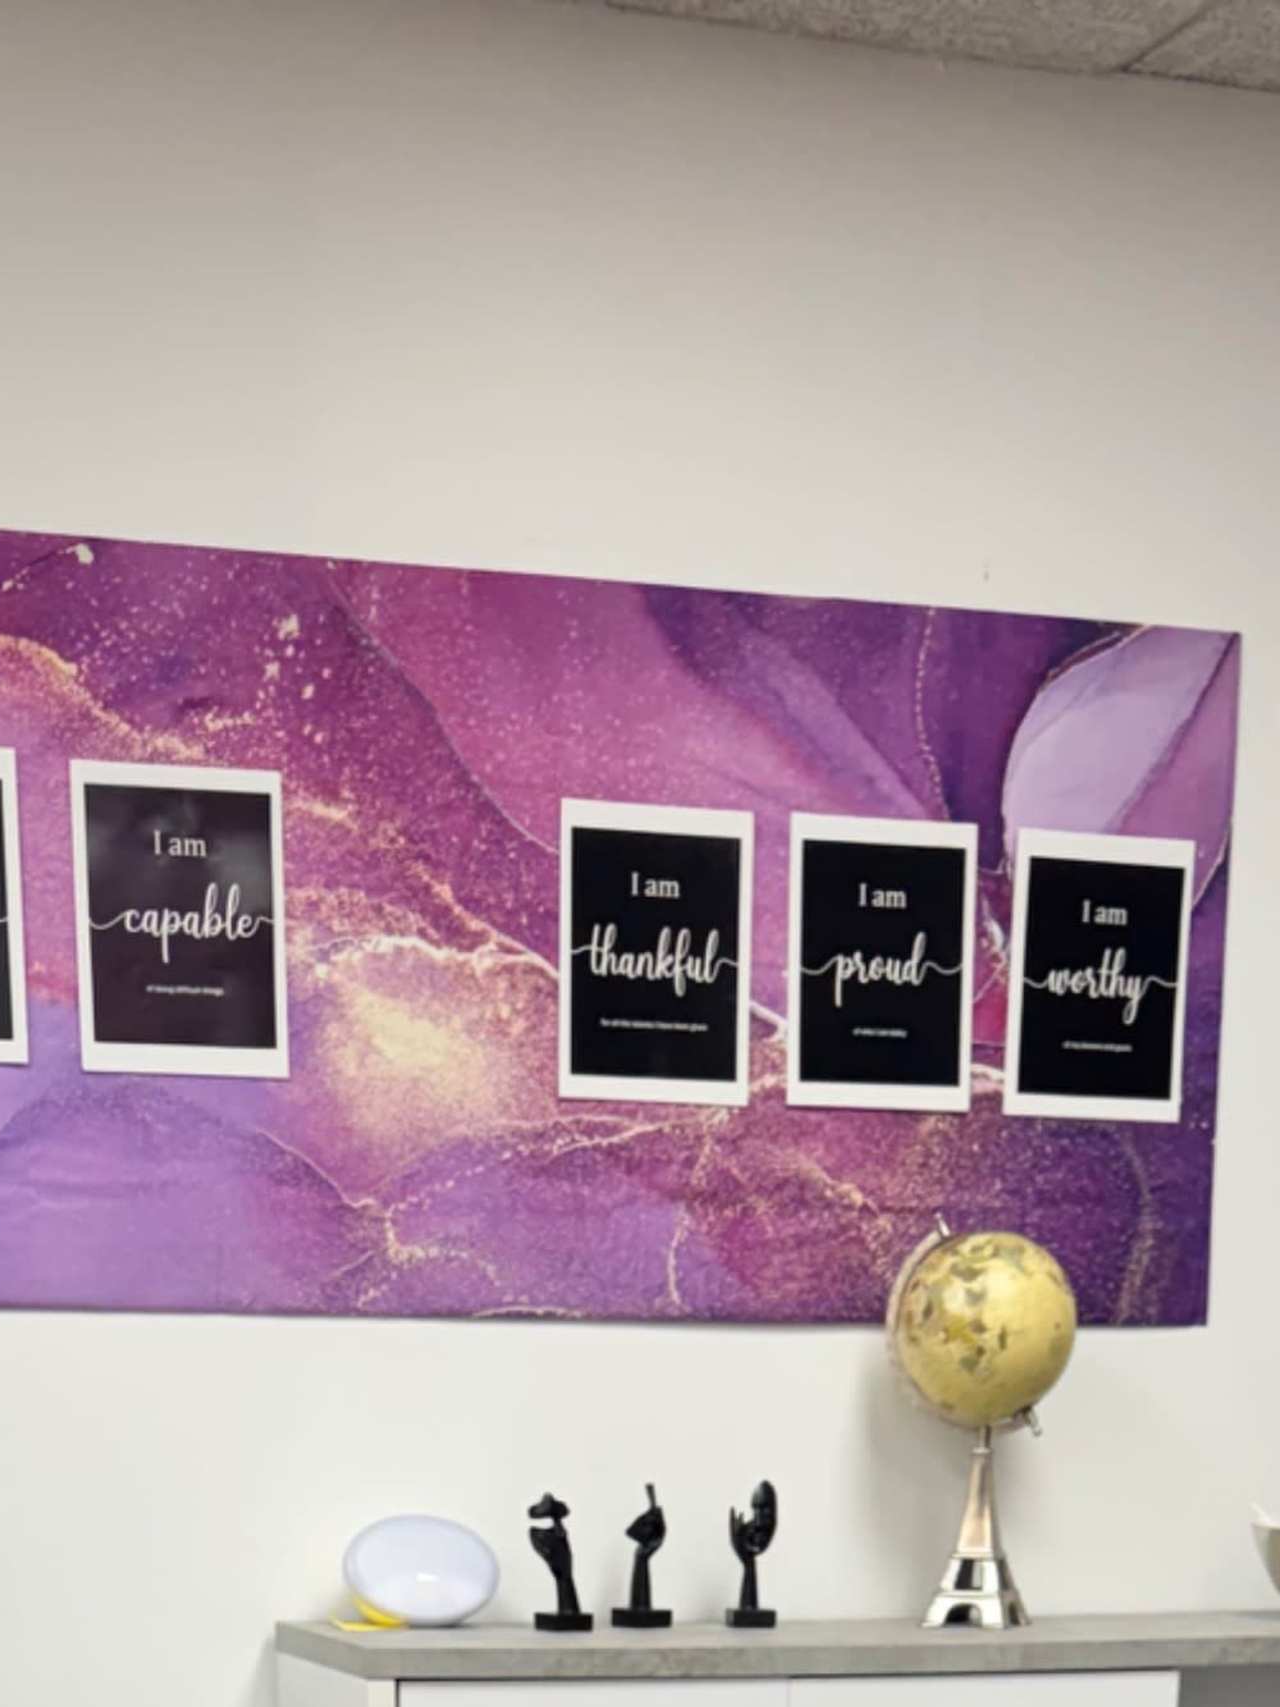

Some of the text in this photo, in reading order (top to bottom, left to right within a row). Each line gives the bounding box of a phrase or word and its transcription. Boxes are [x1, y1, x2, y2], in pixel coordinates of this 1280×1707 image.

[153, 830, 207, 858] I am
[631, 871, 680, 899] I am
[858, 883, 907, 910] I am
[122, 882, 258, 964] capable
[1081, 900, 1128, 927] I am
[589, 923, 720, 997] thankful
[833, 931, 926, 1008] proud
[1046, 948, 1147, 1025] worthy
